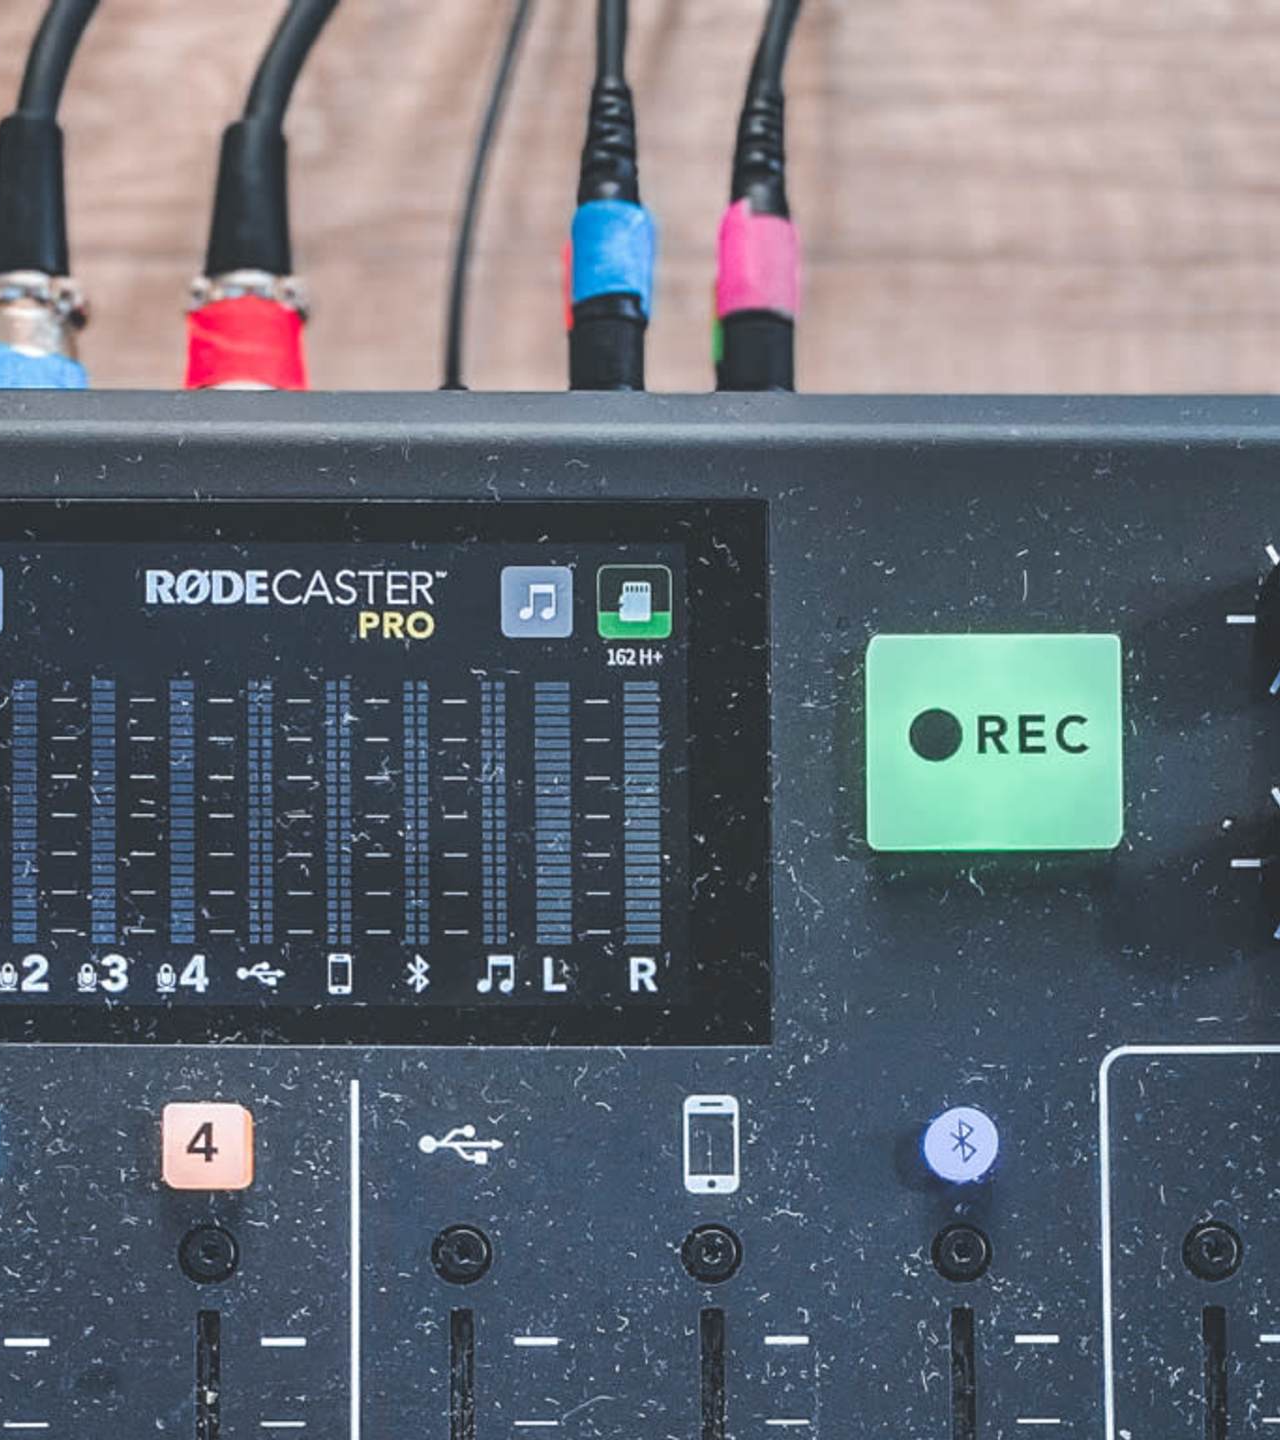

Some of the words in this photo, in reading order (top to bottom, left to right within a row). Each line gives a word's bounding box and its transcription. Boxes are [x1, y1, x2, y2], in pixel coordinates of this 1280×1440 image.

[358, 610, 435, 640] PRO
[606, 647, 637, 666] 162
[639, 647, 664, 666] H+
[978, 715, 1089, 755] REC
[21, 954, 50, 992] 2
[100, 954, 129, 992] 3
[179, 954, 210, 992] 4
[543, 956, 567, 992] L
[629, 956, 659, 992] R
[186, 1121, 219, 1163] 4
